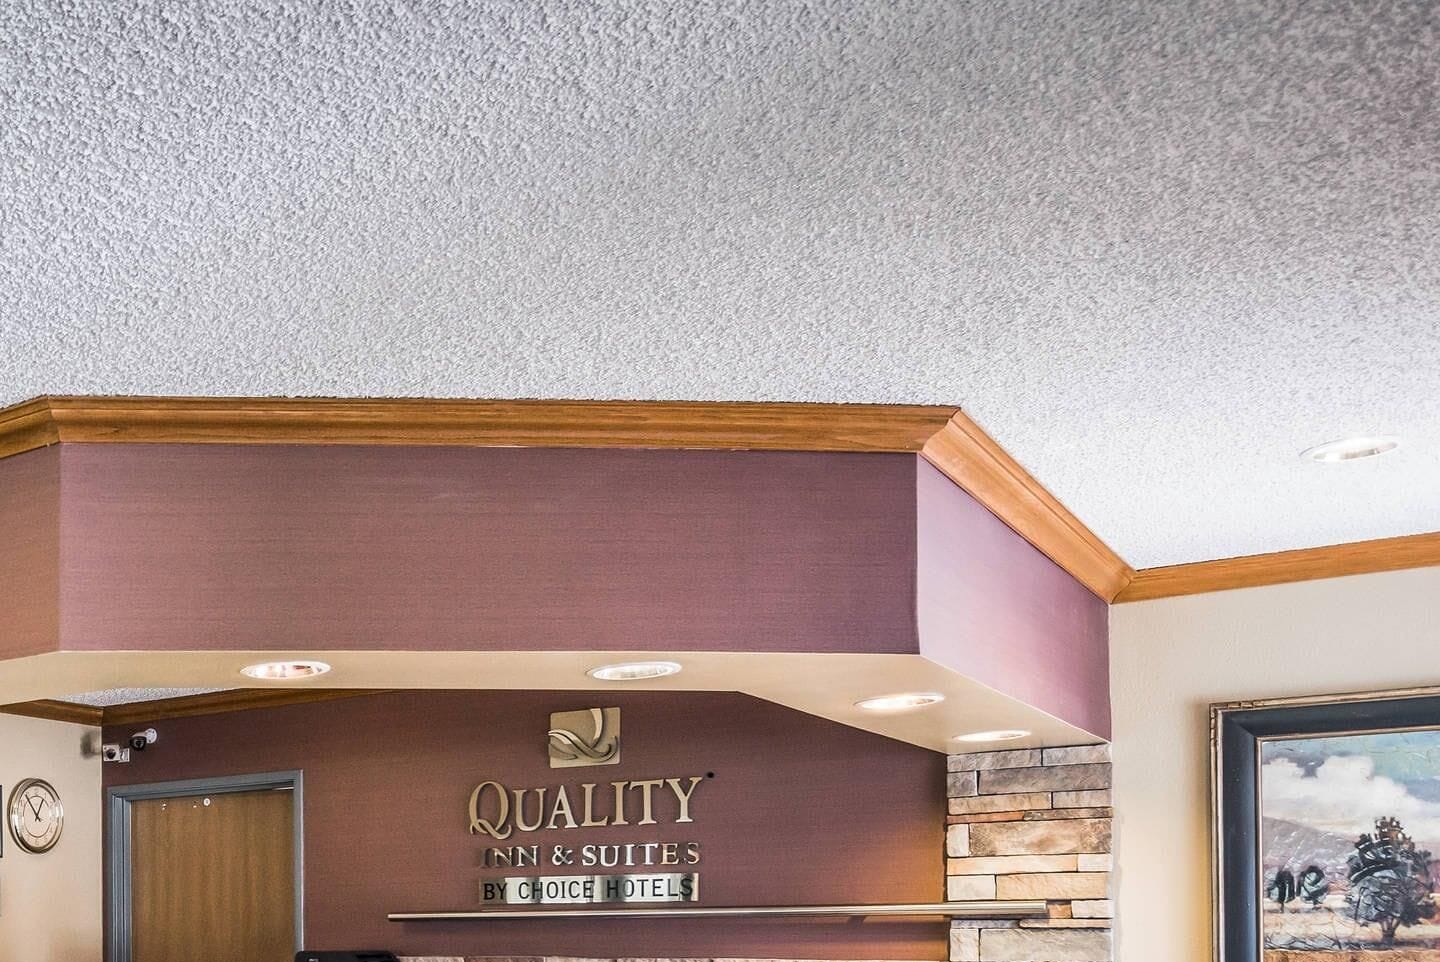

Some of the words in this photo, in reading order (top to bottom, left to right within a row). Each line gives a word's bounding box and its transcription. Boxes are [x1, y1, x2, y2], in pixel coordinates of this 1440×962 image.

[468, 776, 703, 840] QUALITY
[479, 845, 539, 869] INN
[551, 844, 573, 866] &
[582, 842, 700, 867] SUITES
[483, 882, 508, 901] BY
[518, 880, 595, 900] CHOICE
[606, 878, 694, 899] HOTELS
